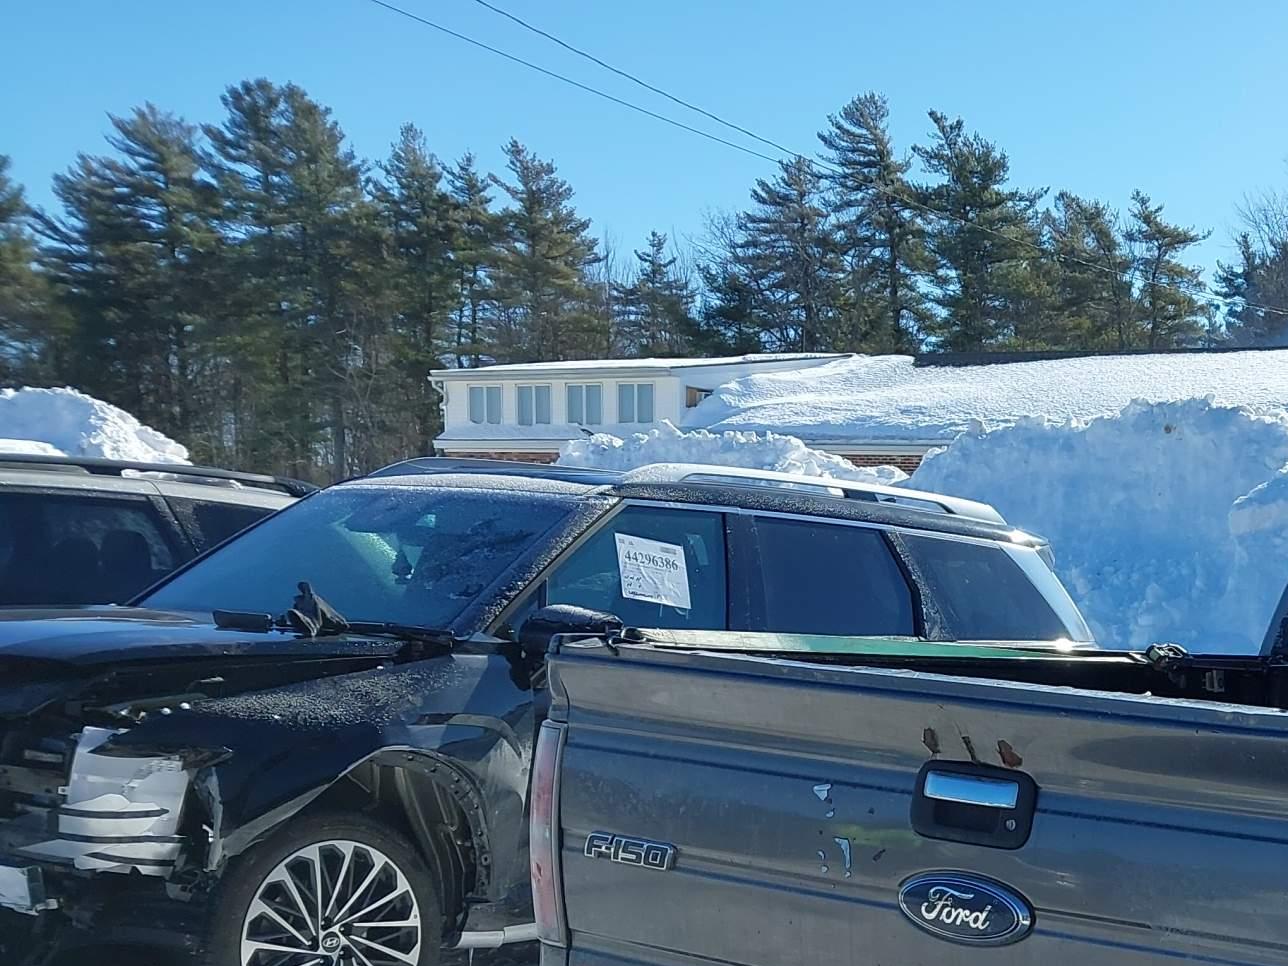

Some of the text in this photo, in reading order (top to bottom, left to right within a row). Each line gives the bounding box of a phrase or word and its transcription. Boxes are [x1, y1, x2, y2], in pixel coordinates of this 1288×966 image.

[624, 550, 679, 571] 44296386
[584, 832, 676, 870] F-150
[920, 886, 992, 930] Ford
